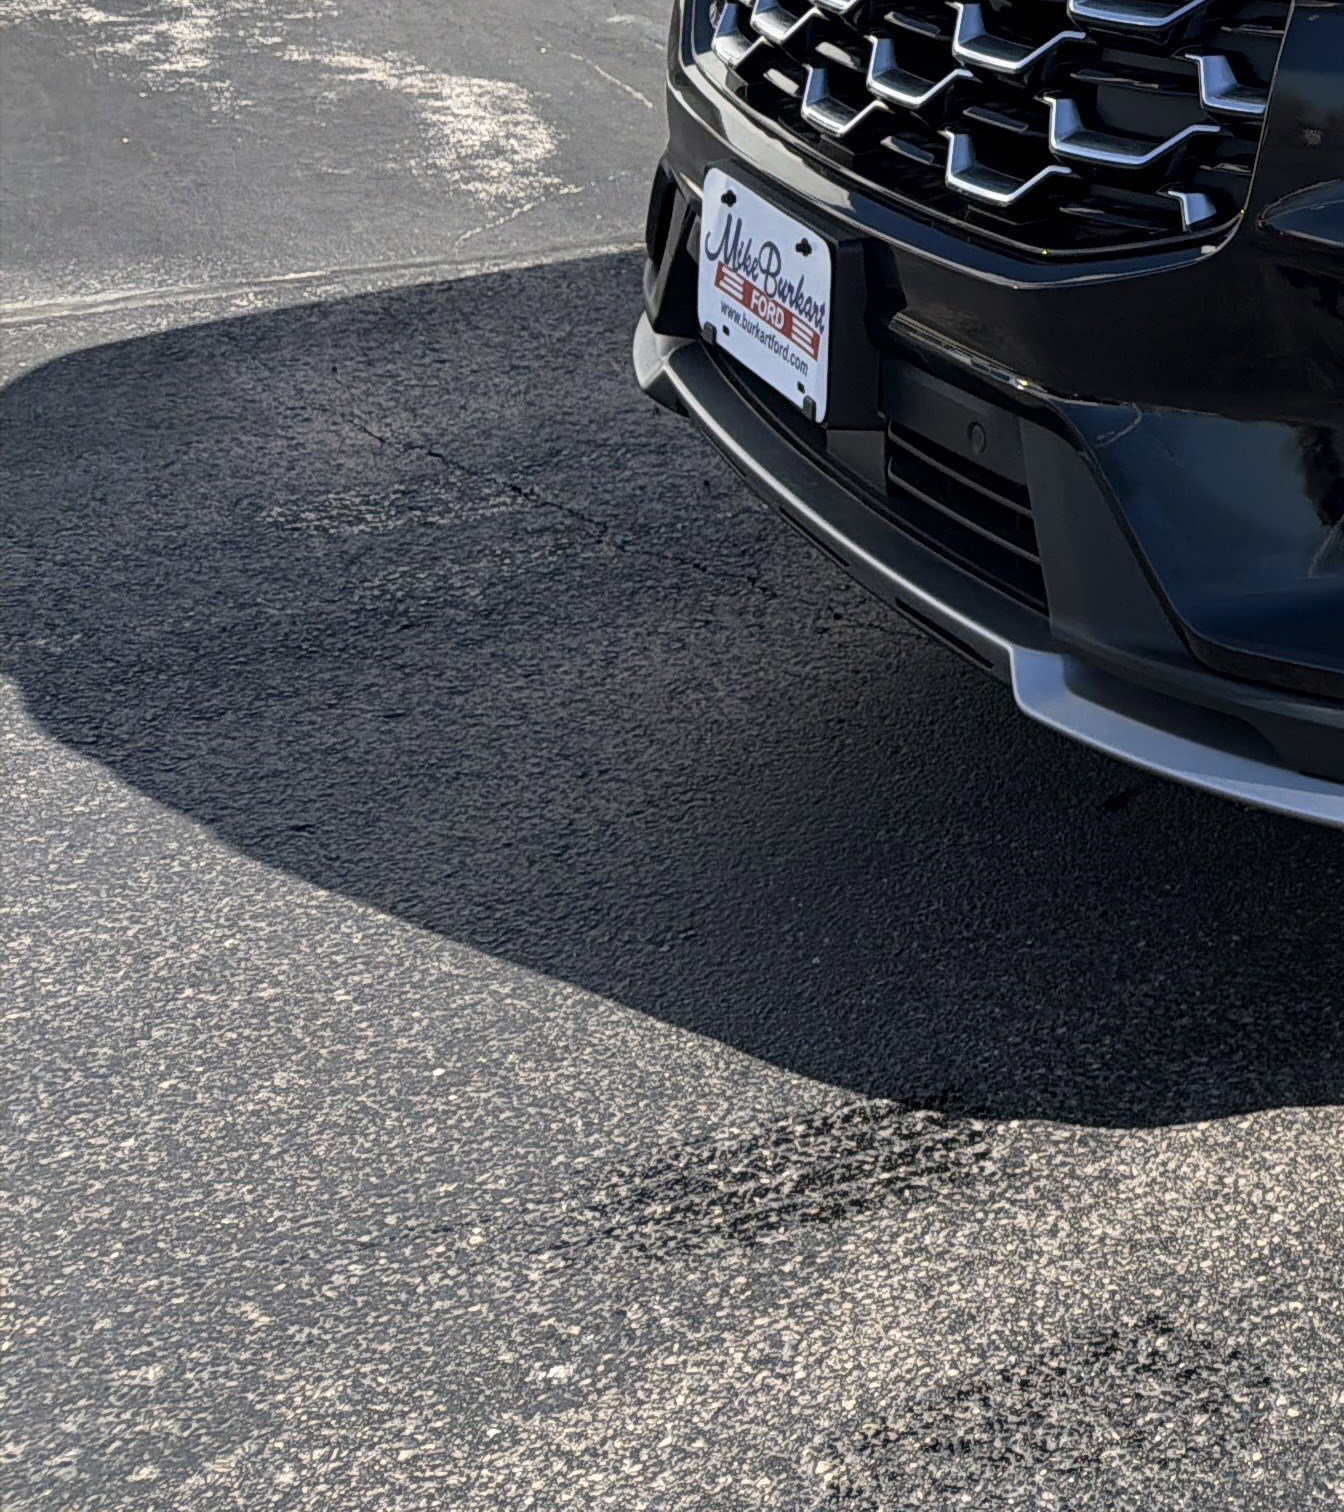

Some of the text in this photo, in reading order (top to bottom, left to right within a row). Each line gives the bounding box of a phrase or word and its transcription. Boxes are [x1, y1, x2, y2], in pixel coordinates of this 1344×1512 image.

[705, 214, 826, 335] Mike Burkart
[750, 290, 785, 330] FORD
[720, 300, 809, 377] www.burkartford.com
